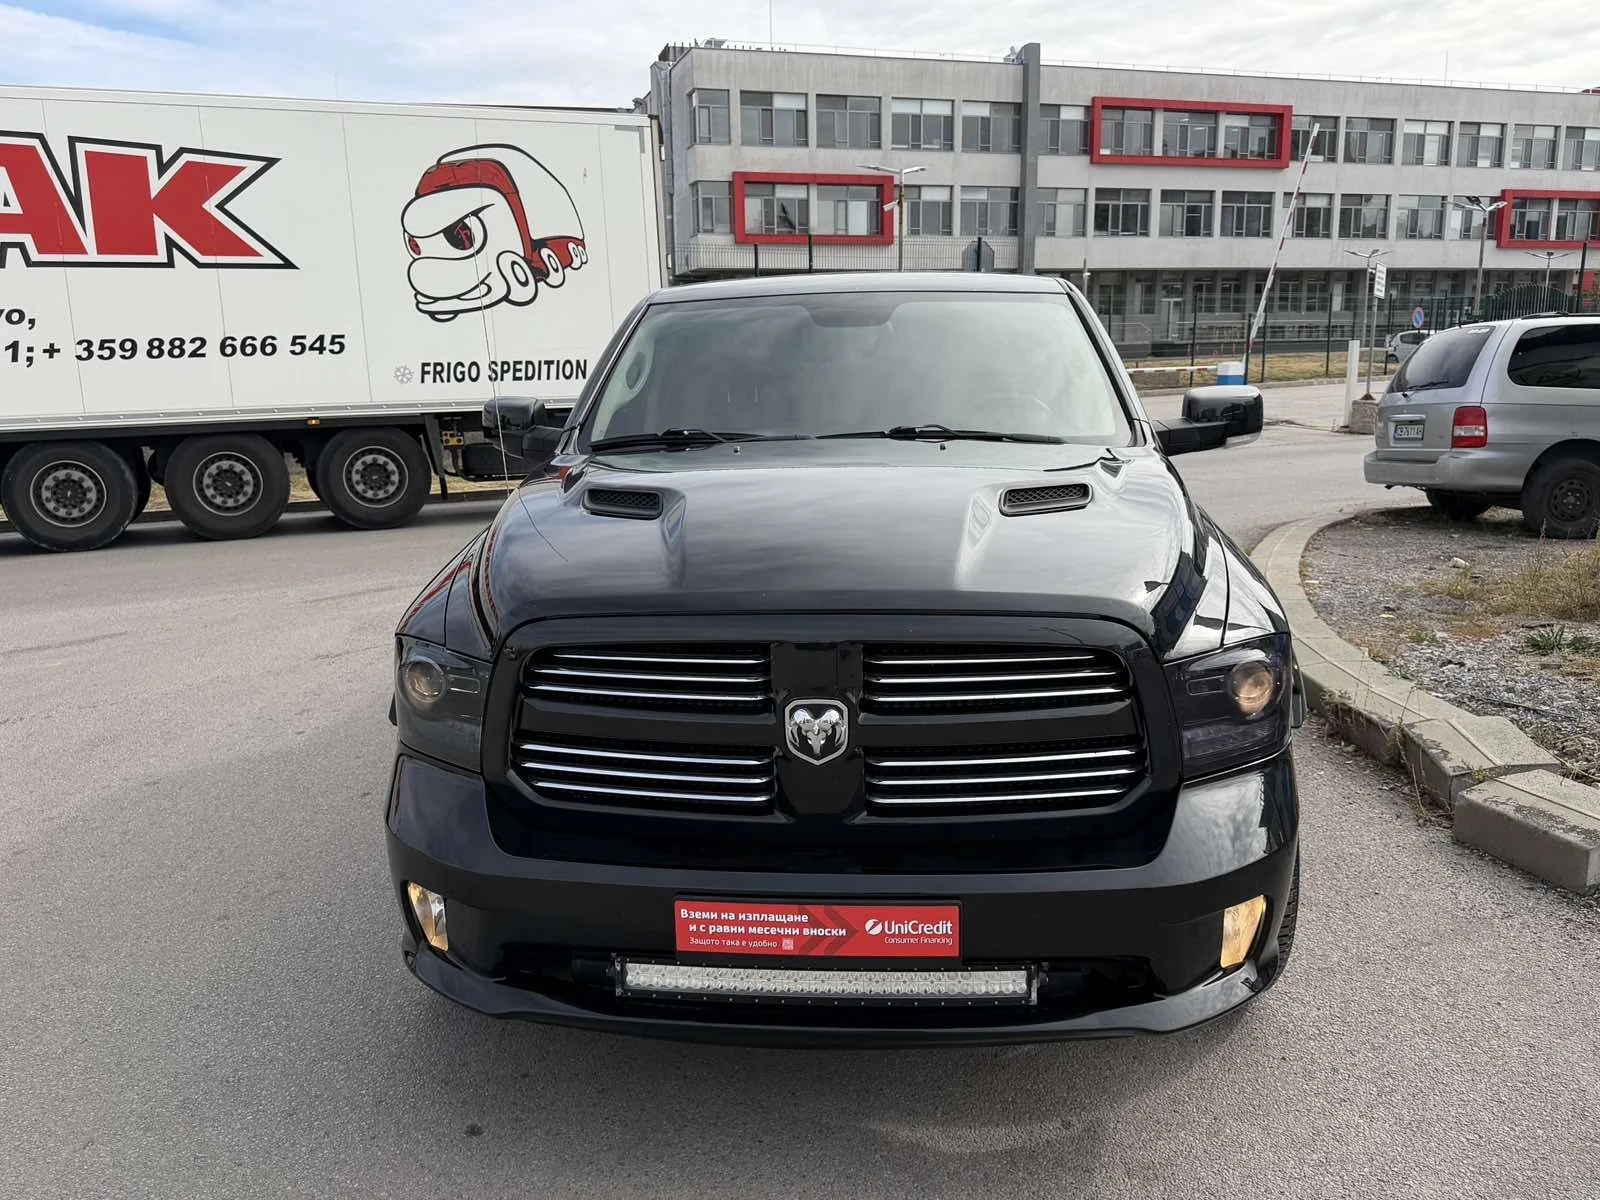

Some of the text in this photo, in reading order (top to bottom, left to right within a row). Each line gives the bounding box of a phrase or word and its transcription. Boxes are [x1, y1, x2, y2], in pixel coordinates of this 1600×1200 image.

[0, 308, 36, 330] o,
[74, 338, 138, 361] 359
[146, 337, 207, 359] 882
[219, 335, 278, 358] 666
[289, 334, 346, 356] 545
[420, 359, 588, 384] FRIGO SPEDITION
[680, 908, 809, 923] Вземи на изплащане
[688, 923, 847, 937] и с равни месечни вноски
[884, 919, 953, 935] UniCredit
[689, 936, 720, 946] Защото
[721, 938, 740, 947] така
[748, 939, 778, 949] удобно
[884, 936, 953, 946] Consumer Financing
